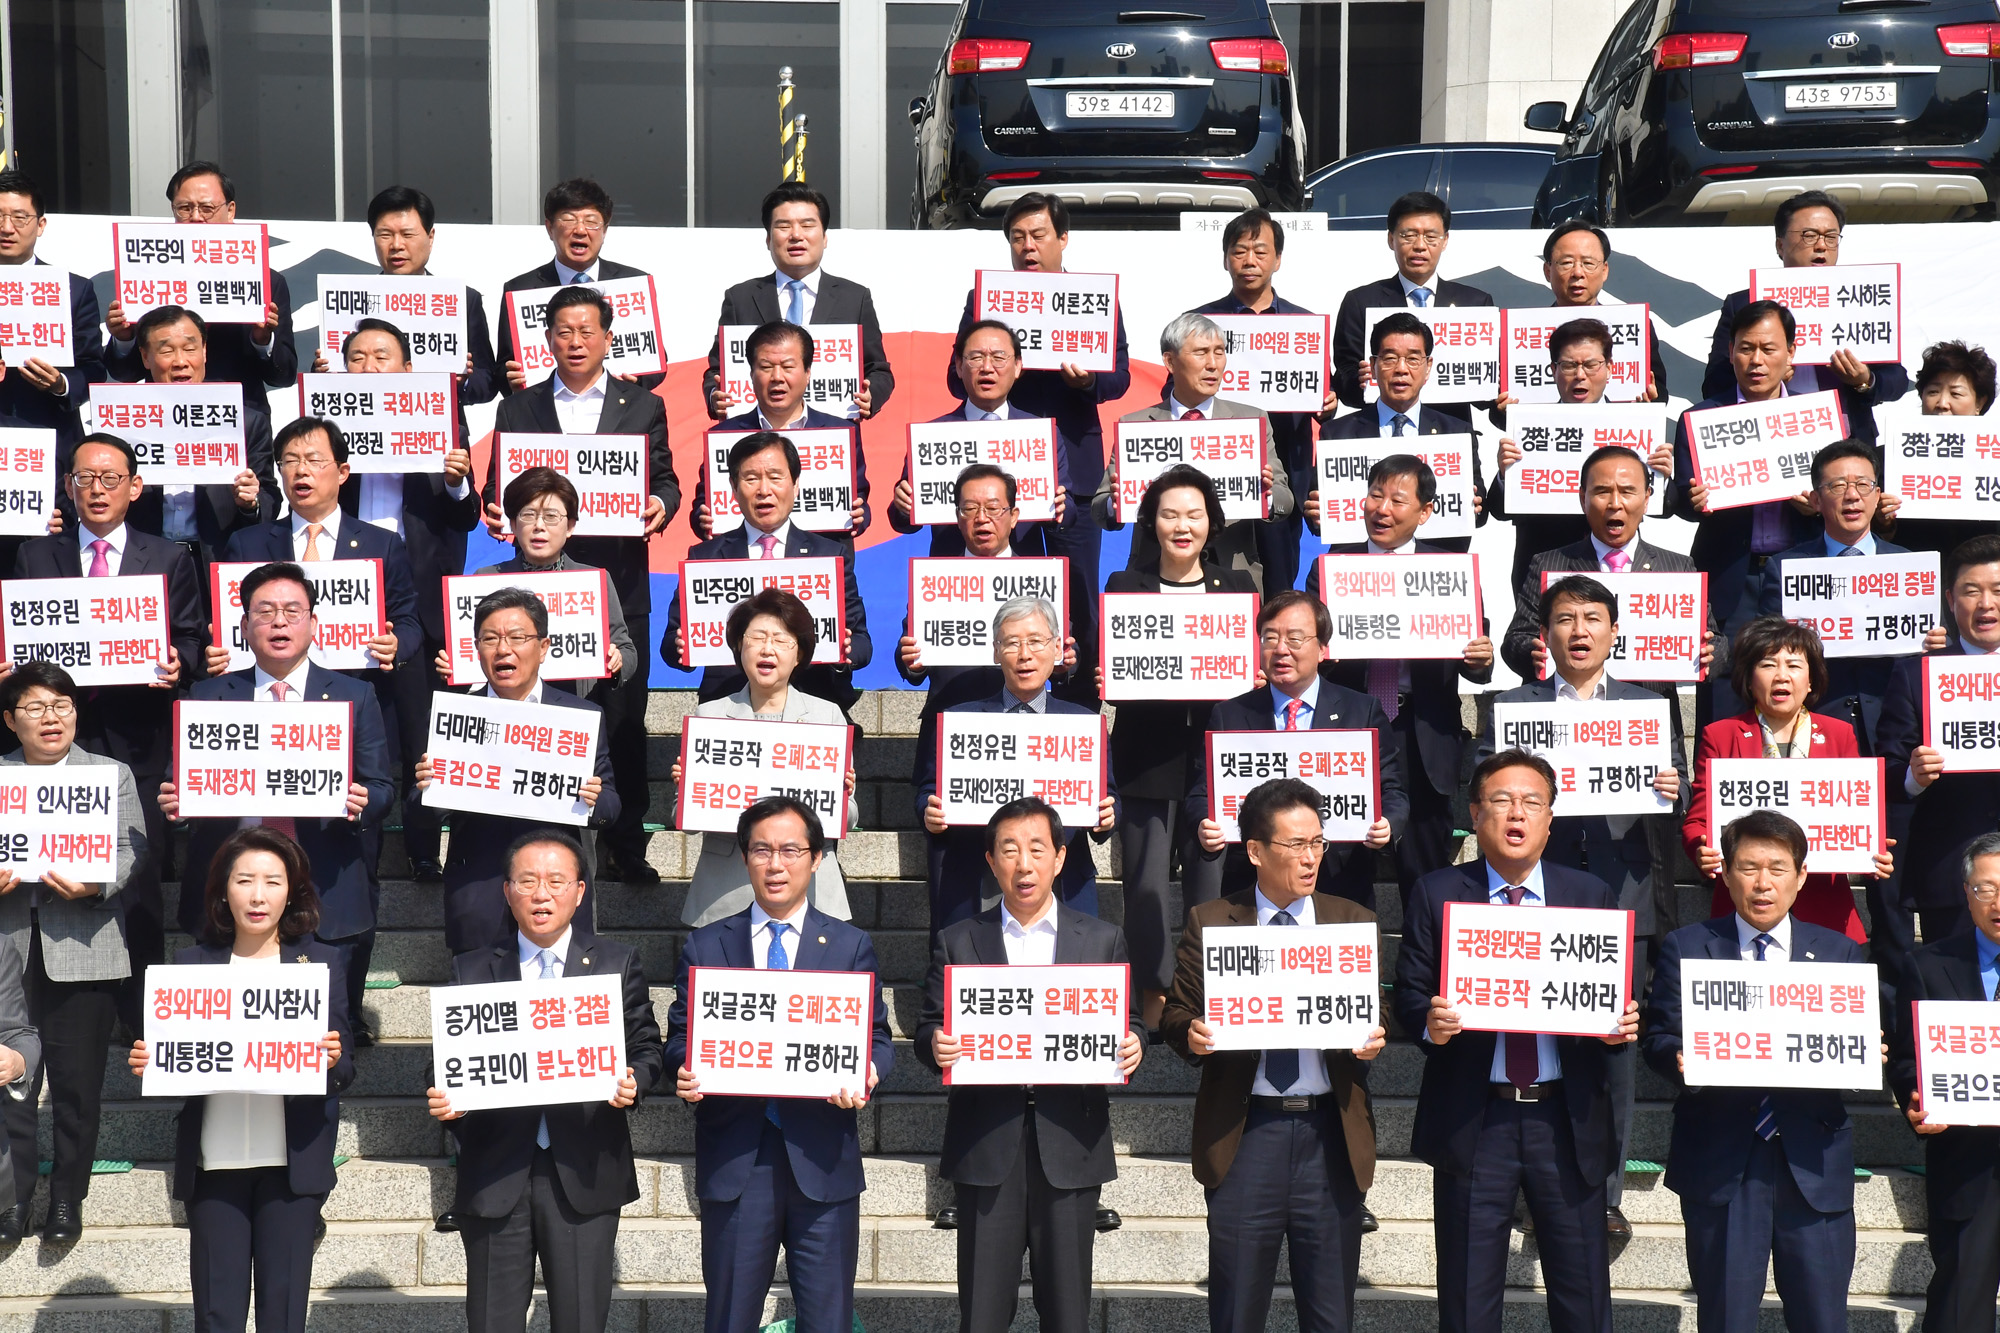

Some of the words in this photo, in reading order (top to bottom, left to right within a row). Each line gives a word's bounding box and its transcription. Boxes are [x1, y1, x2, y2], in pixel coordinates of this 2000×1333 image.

[1110, 46, 1133, 56] KIA
[1832, 35, 1856, 46] KIA
[1078, 97, 1109, 112] 39호
[1119, 97, 1162, 111] 4142
[1796, 89, 1829, 103] 43호
[1840, 86, 1885, 101] 9753
[994, 126, 1039, 136] CARNIVAL
[1707, 120, 1755, 131] CARNIVAL
[126, 239, 184, 263] 민주당의
[192, 240, 256, 264] 댓글공작
[124, 280, 187, 305] 진상규명
[198, 281, 261, 305] 일벌백계
[386, 294, 426, 315] 18억원
[432, 294, 458, 316] 증발
[988, 290, 1044, 313] 댓글공작
[1052, 292, 1109, 316] 여론조작
[1837, 284, 1891, 307] 수사하듯
[1052, 330, 1108, 353] 일벌백계
[1250, 332, 1289, 354] 18억원
[1295, 333, 1320, 354] 증발
[1434, 322, 1493, 346] 댓글공작
[1832, 321, 1891, 345] 수사하라
[1260, 371, 1318, 393] 규명하라
[1437, 361, 1498, 385] 일벌백계
[99, 405, 163, 428] 댓글공작
[173, 405, 237, 427] 여론조작
[311, 393, 373, 416] 헌정유린
[384, 392, 445, 415] 국회사찰
[1700, 418, 1760, 449] 민주당의
[1766, 407, 1832, 439] 댓글공작
[175, 443, 238, 466] 일벌백계
[343, 431, 383, 456] 인정권
[391, 431, 447, 455] 규탄한다
[918, 441, 978, 465] 헌정유린
[988, 439, 1046, 463] 국회사찰
[1126, 437, 1182, 462] 민주당의
[1191, 435, 1254, 460] 댓글공작
[15, 448, 44, 472] 증발
[577, 450, 638, 476] 인사참사
[798, 445, 845, 470] 글공작
[1434, 453, 1461, 476] 증발
[1521, 469, 1581, 494] 특검으로
[1704, 459, 1769, 488] 진상규명
[1212, 476, 1260, 502] 벌백계
[1902, 475, 1961, 499] 특검으로
[580, 492, 641, 518] 사과하라
[693, 577, 754, 604] 민주당의
[922, 576, 983, 602] 청와대의
[1335, 572, 1394, 596] 청와대의
[1404, 572, 1467, 596] 인사참사
[1853, 573, 1898, 597] 18억원
[1905, 571, 1936, 596] 증발
[11, 599, 79, 626] 헌정유린
[91, 597, 158, 623] 국회사찰
[1630, 594, 1694, 618] 국회사찰
[925, 620, 986, 646] 대통령은
[1112, 615, 1173, 639] 헌정유린
[1185, 614, 1247, 638] 국회사찰
[1339, 615, 1400, 639] 대통령은
[1411, 615, 1472, 639] 사과하라
[99, 638, 161, 664] 규탄한다
[549, 633, 597, 658] 명하라
[1635, 636, 1694, 660] 규탄한다
[1112, 656, 1182, 680] 문재인정권
[1191, 655, 1247, 680] 규탄한다
[188, 723, 258, 750] 헌정유린
[271, 724, 342, 751] 국회사찰
[505, 724, 552, 752] 18억원
[558, 730, 589, 757] 증발
[1574, 720, 1622, 746] 18억원
[1628, 720, 1659, 746] 증발
[1942, 721, 2000, 750] 대통령
[695, 739, 762, 767] 댓글공작
[772, 743, 839, 772] 은폐조작
[951, 734, 1015, 760] 헌정유린
[1028, 736, 1094, 761] 국회사찰
[1221, 752, 1288, 777] 댓글공작
[1299, 752, 1366, 777] 은폐조작
[188, 769, 255, 795] 독재정치
[266, 769, 342, 796] 부활인가?
[432, 758, 501, 790] 특검으로
[512, 769, 582, 801] 규명하라
[38, 786, 110, 814] 인사참사
[1720, 780, 1788, 807] 헌정유린
[1801, 780, 1871, 806] 국회사찰
[39, 834, 112, 863] 사과하라
[1806, 825, 1872, 851] 규탄한다
[1457, 929, 1541, 960] 국정원댓글
[1551, 933, 1618, 963] 수사하듯
[1281, 946, 1332, 974] 18억원
[1339, 945, 1372, 973] 증발
[154, 988, 231, 1020] 청와대의
[243, 989, 320, 1020] 인사참사
[960, 988, 1033, 1015] 댓글공작
[1045, 988, 1118, 1015] 은폐조작
[1456, 977, 1530, 1008] 댓글공작
[1542, 981, 1617, 1012] 수사하라
[1770, 984, 1823, 1012] 18억원
[1830, 985, 1865, 1013] 증발
[446, 1001, 518, 1036] 증거인멸
[703, 992, 776, 1022] 댓글공작
[788, 995, 861, 1025] 은폐조작
[1208, 997, 1283, 1026] 특검으로
[1297, 995, 1373, 1024] 규명하라
[156, 1041, 233, 1073] 대통령은
[243, 1041, 321, 1074] 사과하라
[700, 1040, 772, 1068] 특검으로
[785, 1043, 858, 1074] 규명하라
[959, 1033, 1032, 1061] 특검으로
[1044, 1034, 1117, 1061] 규명하라
[1694, 1032, 1772, 1060] 특검으로
[1786, 1034, 1866, 1064] 규명하라
[537, 1046, 616, 1080] 분노한다
